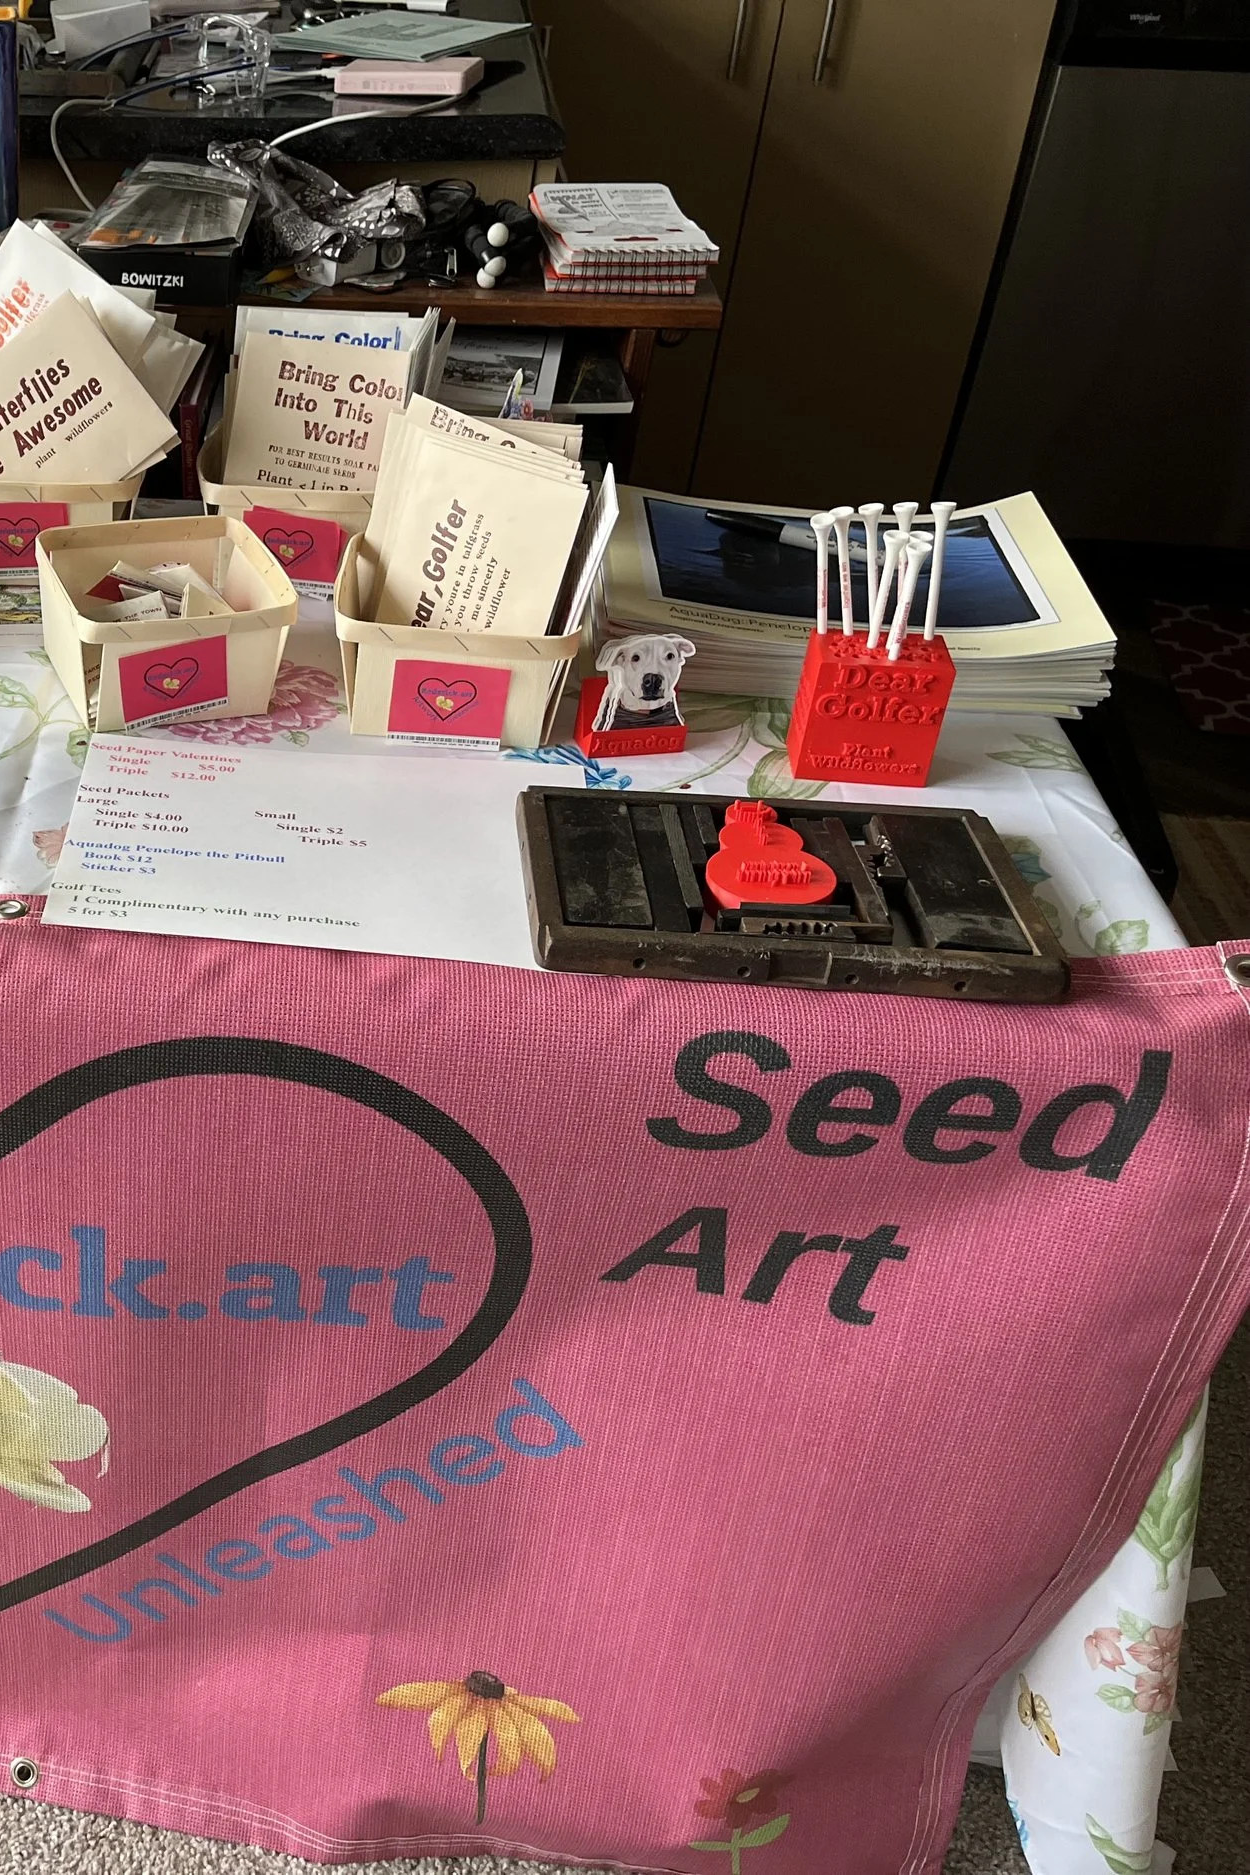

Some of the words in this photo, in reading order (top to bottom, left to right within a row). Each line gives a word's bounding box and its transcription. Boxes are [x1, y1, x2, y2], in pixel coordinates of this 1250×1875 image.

[120, 272, 184, 288] BOWITZKI
[278, 360, 340, 392] Bring
[12, 376, 103, 458] Awesome
[274, 387, 319, 414] Into
[333, 398, 374, 425] This
[34, 448, 56, 469] plant
[64, 400, 113, 444] wildflowers
[302, 419, 369, 451] World
[274, 457, 285, 465] TO
[333, 468, 356, 479] SEEDS
[286, 447, 305, 458] BEST
[308, 452, 341, 464] RESULTS
[344, 458, 364, 469] SOAK
[257, 469, 292, 486] Plant
[445, 580, 461, 614] youre
[456, 565, 466, 576] in
[454, 605, 466, 626] you
[463, 564, 479, 600] throw
[476, 531, 492, 560] seeds
[484, 568, 511, 629] wildflower
[472, 603, 482, 621] me
[834, 663, 937, 695] Dear
[816, 693, 941, 725] Golfer
[91, 742, 122, 752] Seed
[127, 745, 167, 757] Paper
[171, 750, 242, 764] Valentines
[841, 742, 894, 758] Plant
[107, 764, 149, 776] Triple
[171, 771, 216, 782] $12.00
[109, 754, 151, 765] Single
[198, 764, 235, 773] $5.00
[76, 795, 119, 806] Large
[79, 783, 111, 794] Seed
[116, 787, 170, 799] Packets
[95, 808, 139, 819] Single
[144, 812, 183, 822] $4.00
[254, 810, 297, 820] Small
[92, 818, 137, 834] Triple
[142, 822, 189, 835] $10.00
[276, 823, 322, 833] Single
[326, 827, 344, 835] $2
[64, 838, 131, 852] Aquadog
[135, 844, 202, 858] Penelope
[206, 850, 230, 859] the
[234, 852, 285, 863] Pitbull
[298, 835, 344, 846] Triple
[350, 839, 368, 848] $5
[80, 862, 135, 874] Sticker
[138, 866, 157, 875] $3
[83, 851, 123, 862] Book
[126, 854, 153, 864] $12
[50, 882, 84, 892] Golf
[89, 884, 122, 895] Tees
[81, 907, 105, 916] for
[109, 910, 128, 918] $3
[84, 895, 209, 914] Complimentary
[212, 907, 248, 917] with
[252, 910, 283, 921] any
[287, 913, 361, 928] purchase
[645, 1029, 1174, 1184] Seed
[598, 1205, 911, 1328] Art
[43, 1375, 589, 1652] Unleashed
